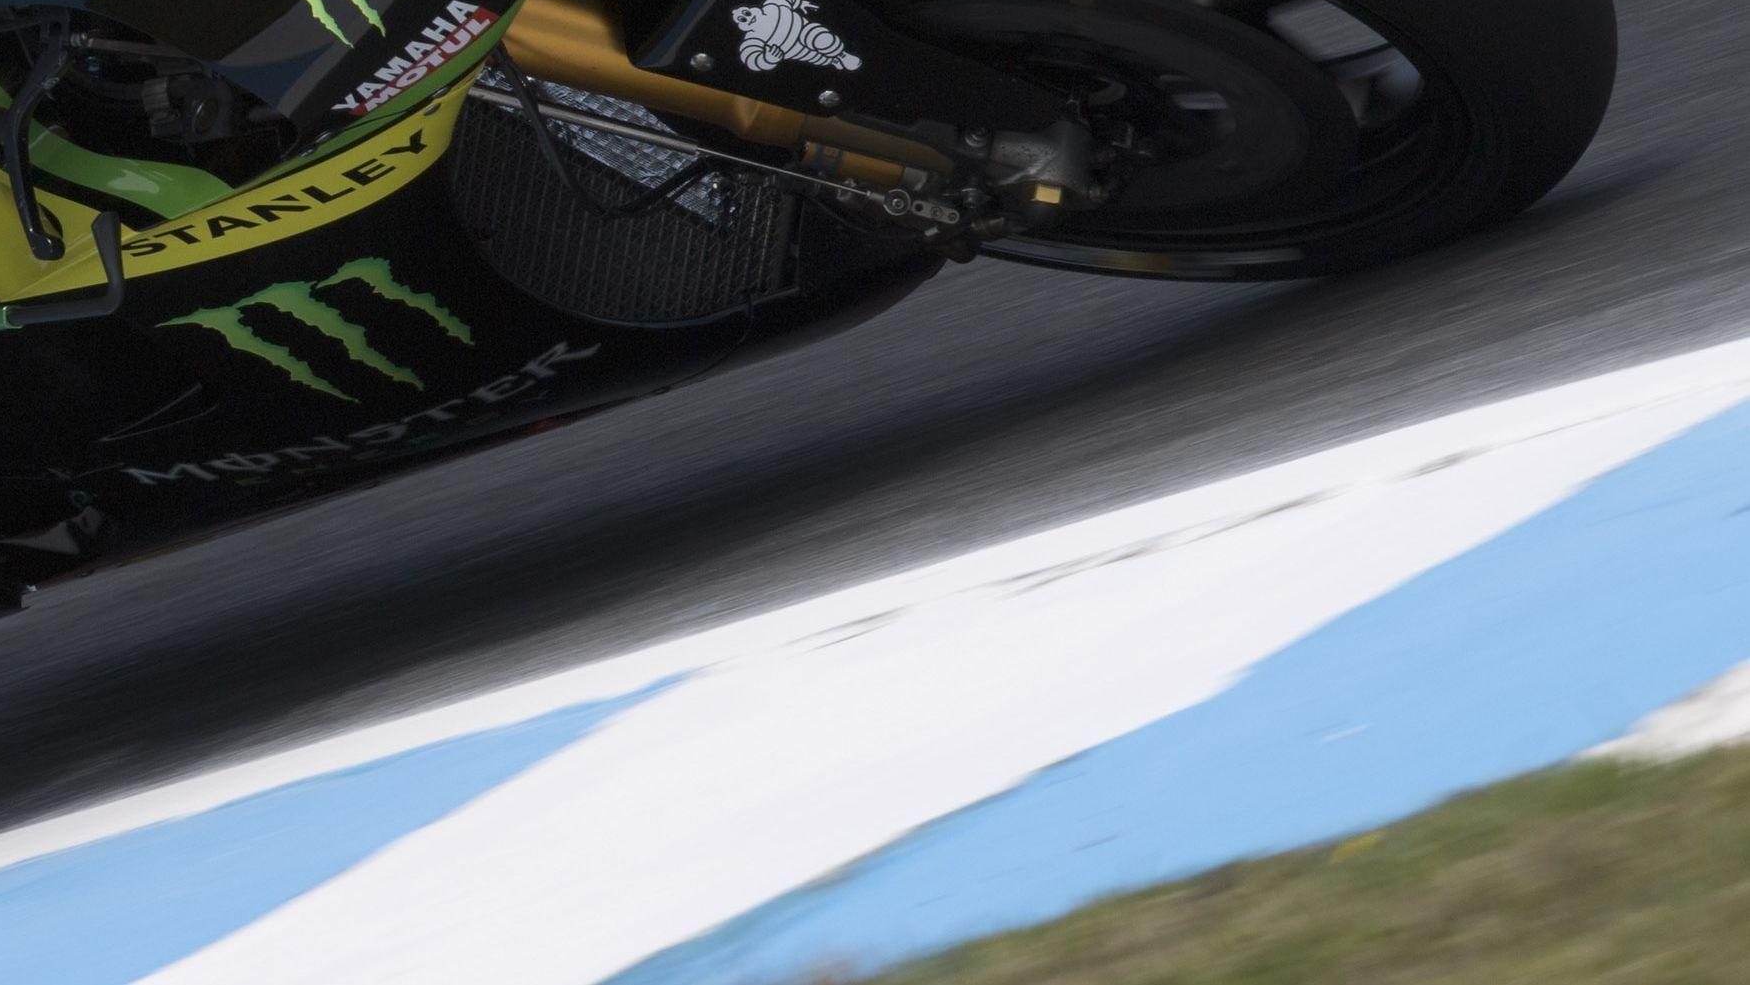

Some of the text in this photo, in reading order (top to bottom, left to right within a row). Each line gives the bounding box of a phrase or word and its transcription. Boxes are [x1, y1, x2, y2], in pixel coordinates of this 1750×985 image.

[332, 0, 481, 116] YAMAHA
[360, 13, 493, 117] MOTUL
[119, 128, 431, 259] STANLEY
